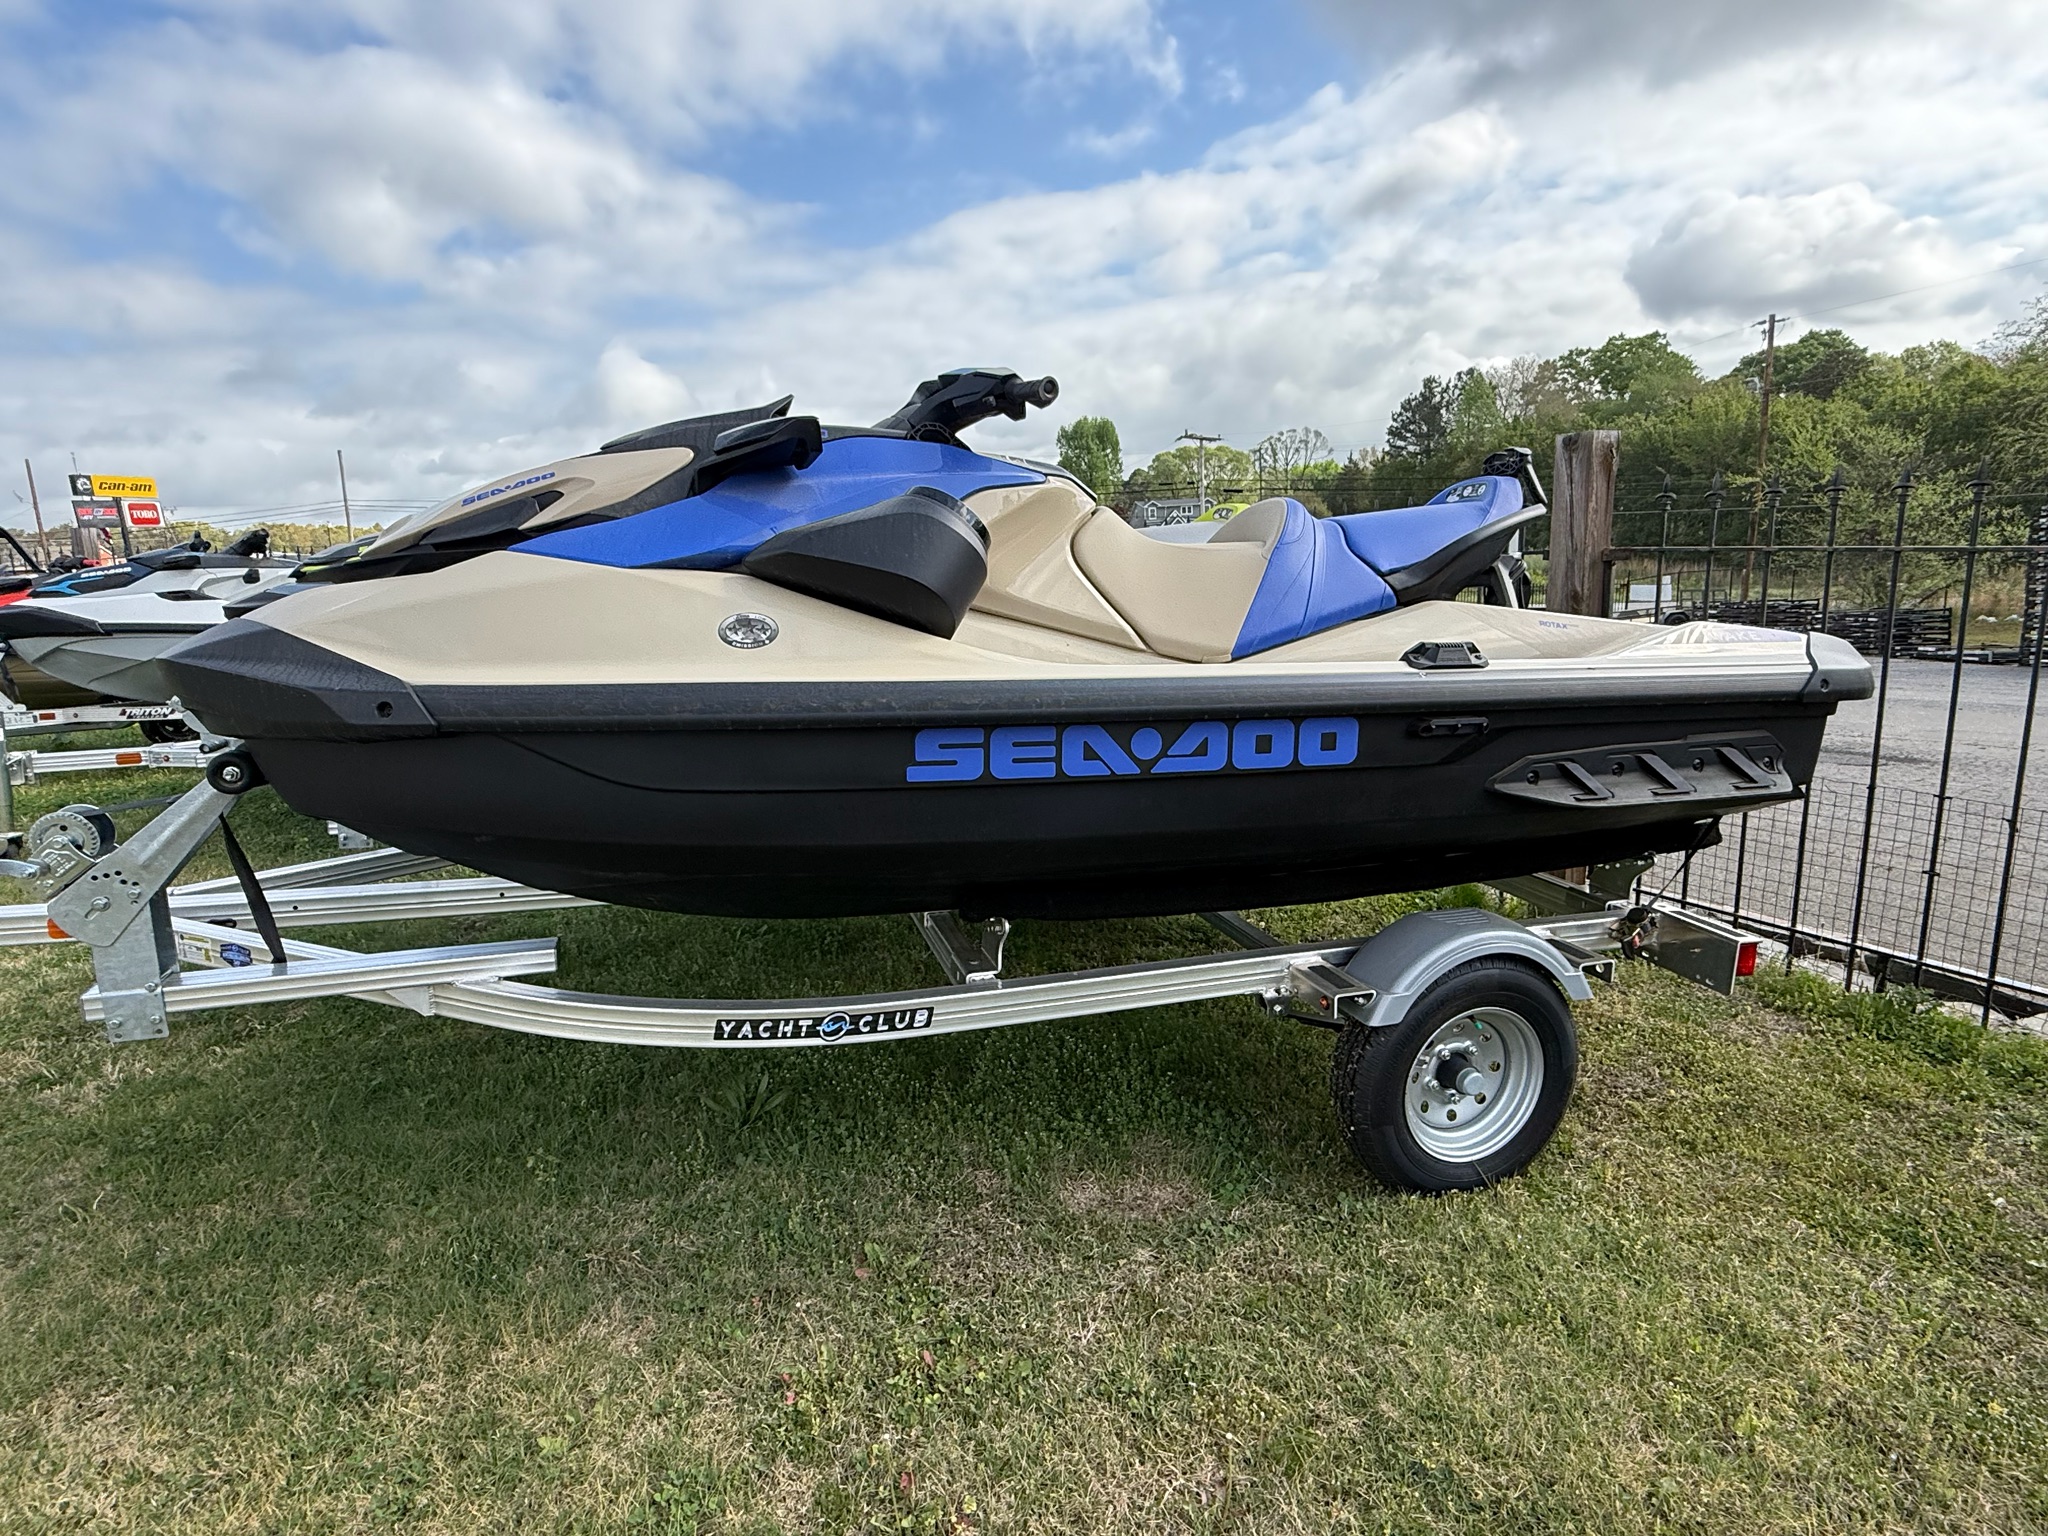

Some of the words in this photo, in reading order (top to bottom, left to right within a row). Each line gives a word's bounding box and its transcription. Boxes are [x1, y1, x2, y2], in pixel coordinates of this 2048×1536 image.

[98, 481, 152, 492] can-am
[130, 509, 158, 519] TORO
[1538, 620, 1568, 629] ROTAX
[125, 707, 173, 716] TRITON
[720, 1019, 814, 1039] YACHT
[858, 1009, 929, 1033] CLUB
